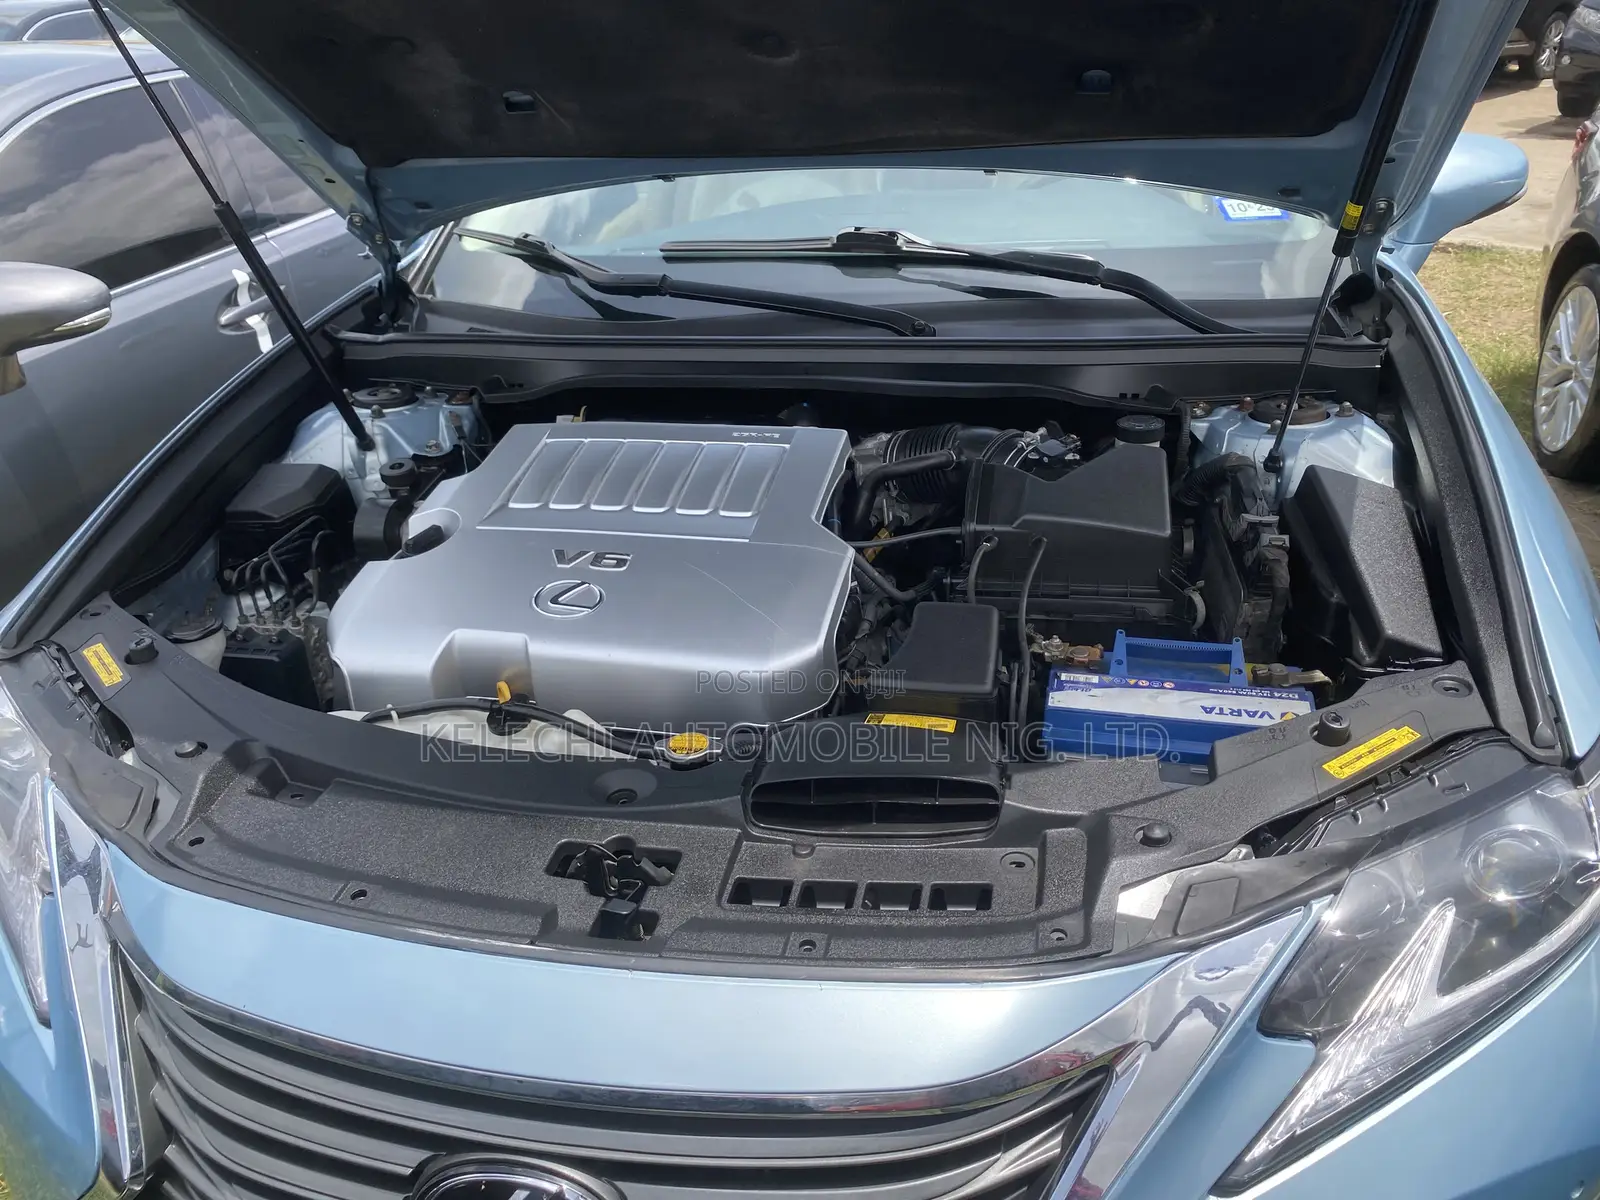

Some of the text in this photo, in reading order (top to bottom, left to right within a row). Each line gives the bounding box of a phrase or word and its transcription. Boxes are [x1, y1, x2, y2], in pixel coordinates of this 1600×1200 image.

[1227, 202, 1248, 213] 10
[551, 548, 635, 571] V6
[1273, 691, 1299, 699] D24
[1199, 705, 1276, 720] VARTA
